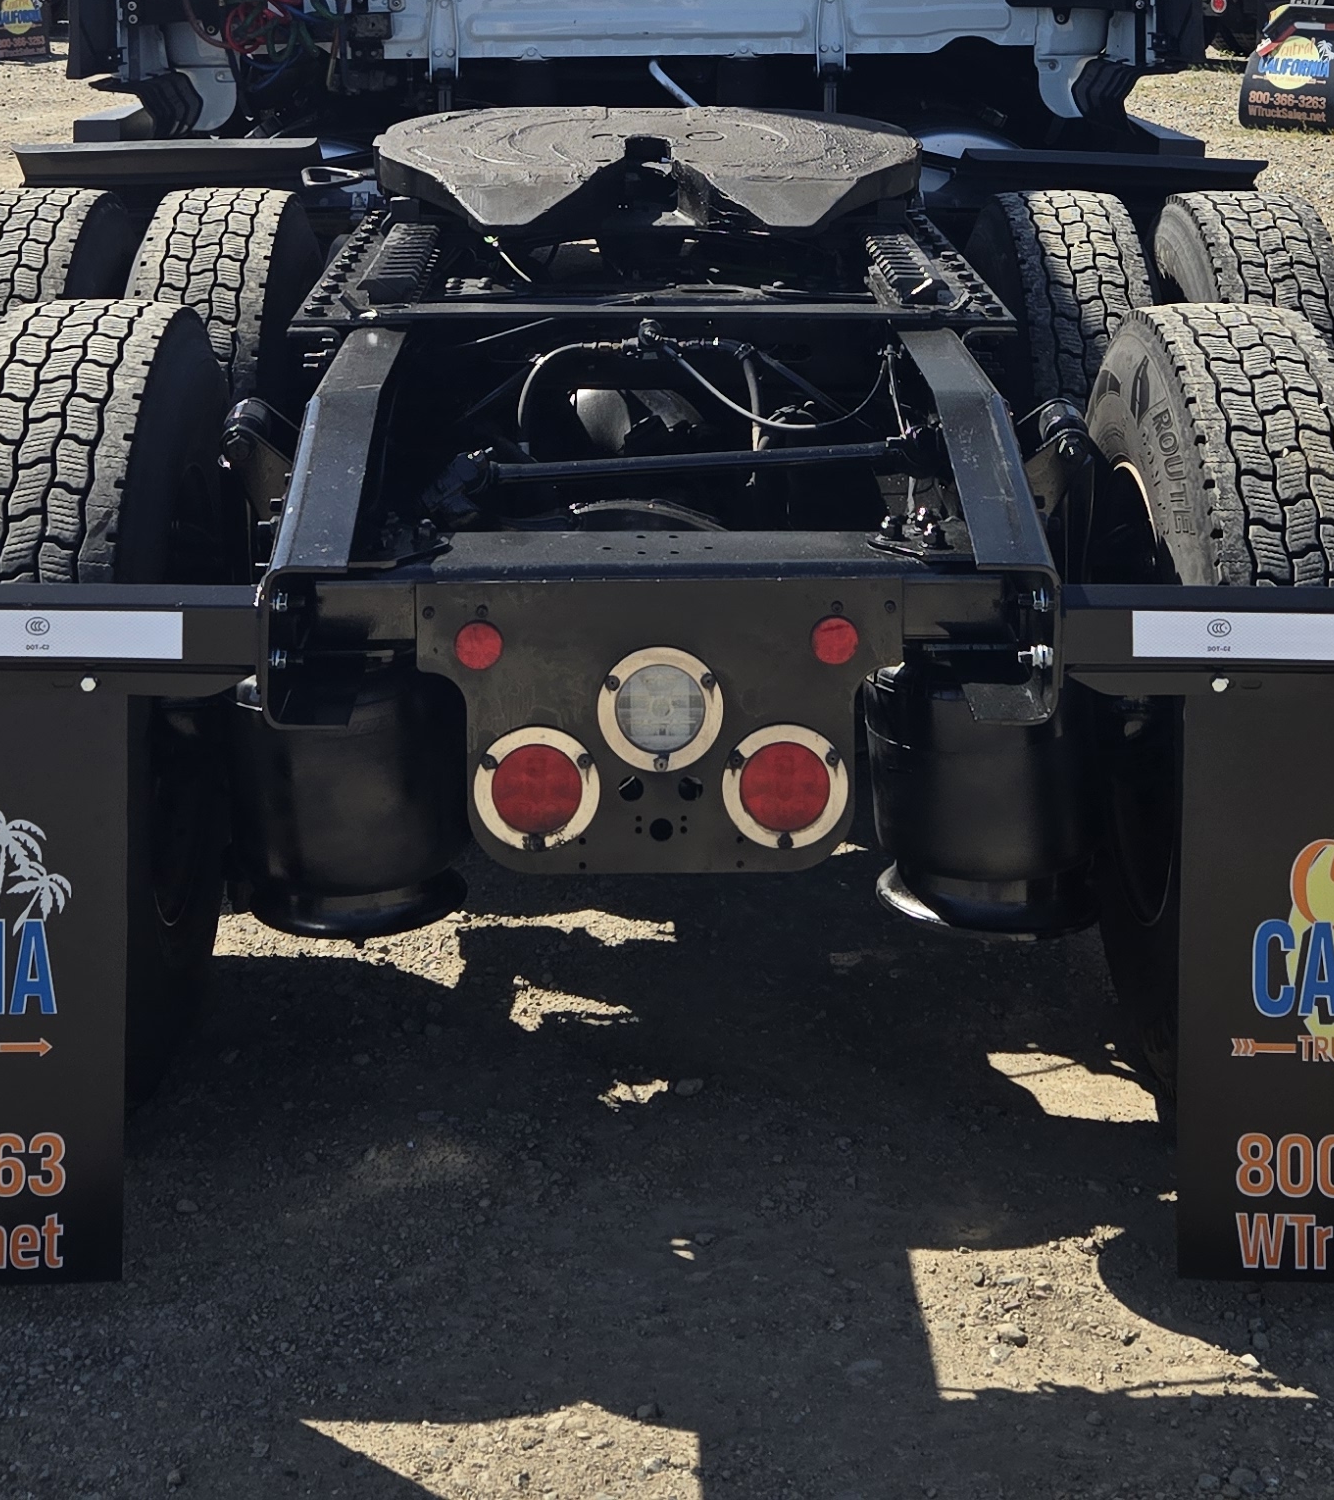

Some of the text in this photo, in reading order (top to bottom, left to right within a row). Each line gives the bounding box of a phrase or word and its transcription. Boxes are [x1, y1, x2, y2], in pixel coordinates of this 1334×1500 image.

[1258, 56, 1330, 78] CALIFORNIA
[1248, 90, 1326, 110] 800-366-3263
[1248, 104, 1326, 123] WTruckSales.net
[1152, 407, 1196, 536] ROUTE
